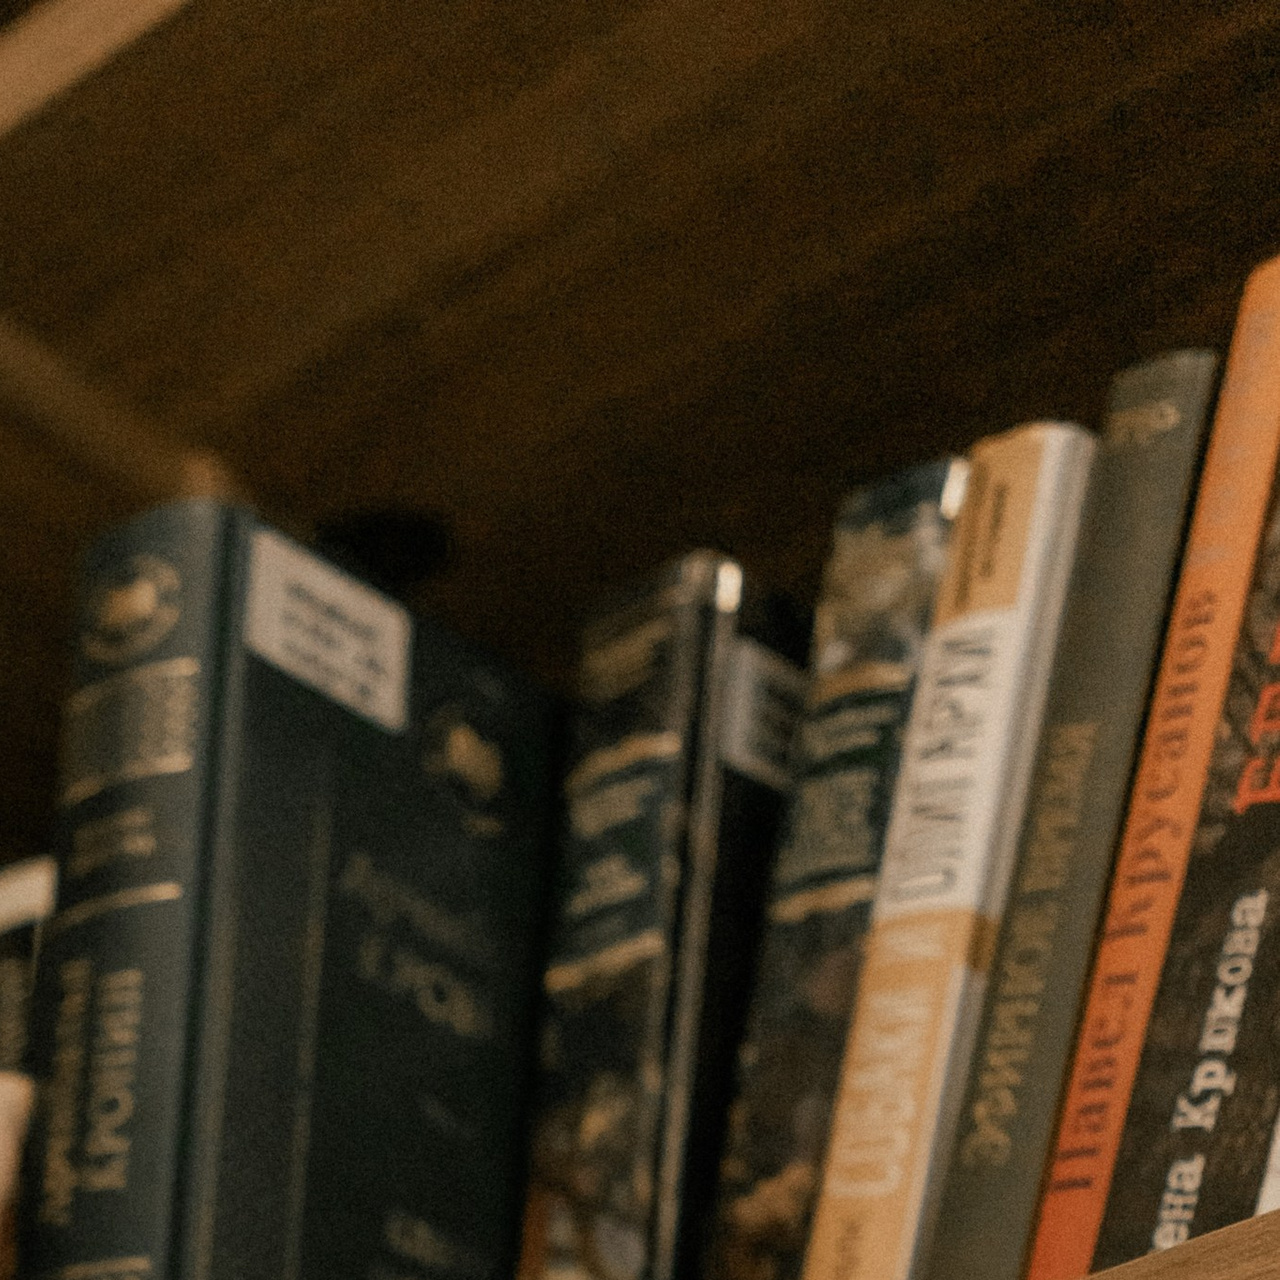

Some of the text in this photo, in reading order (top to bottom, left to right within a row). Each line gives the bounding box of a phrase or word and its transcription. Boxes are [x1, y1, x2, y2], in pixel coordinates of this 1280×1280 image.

[1047, 588, 1220, 1196] Павел Крусанов
[1172, 892, 1266, 1130] Крюкова
